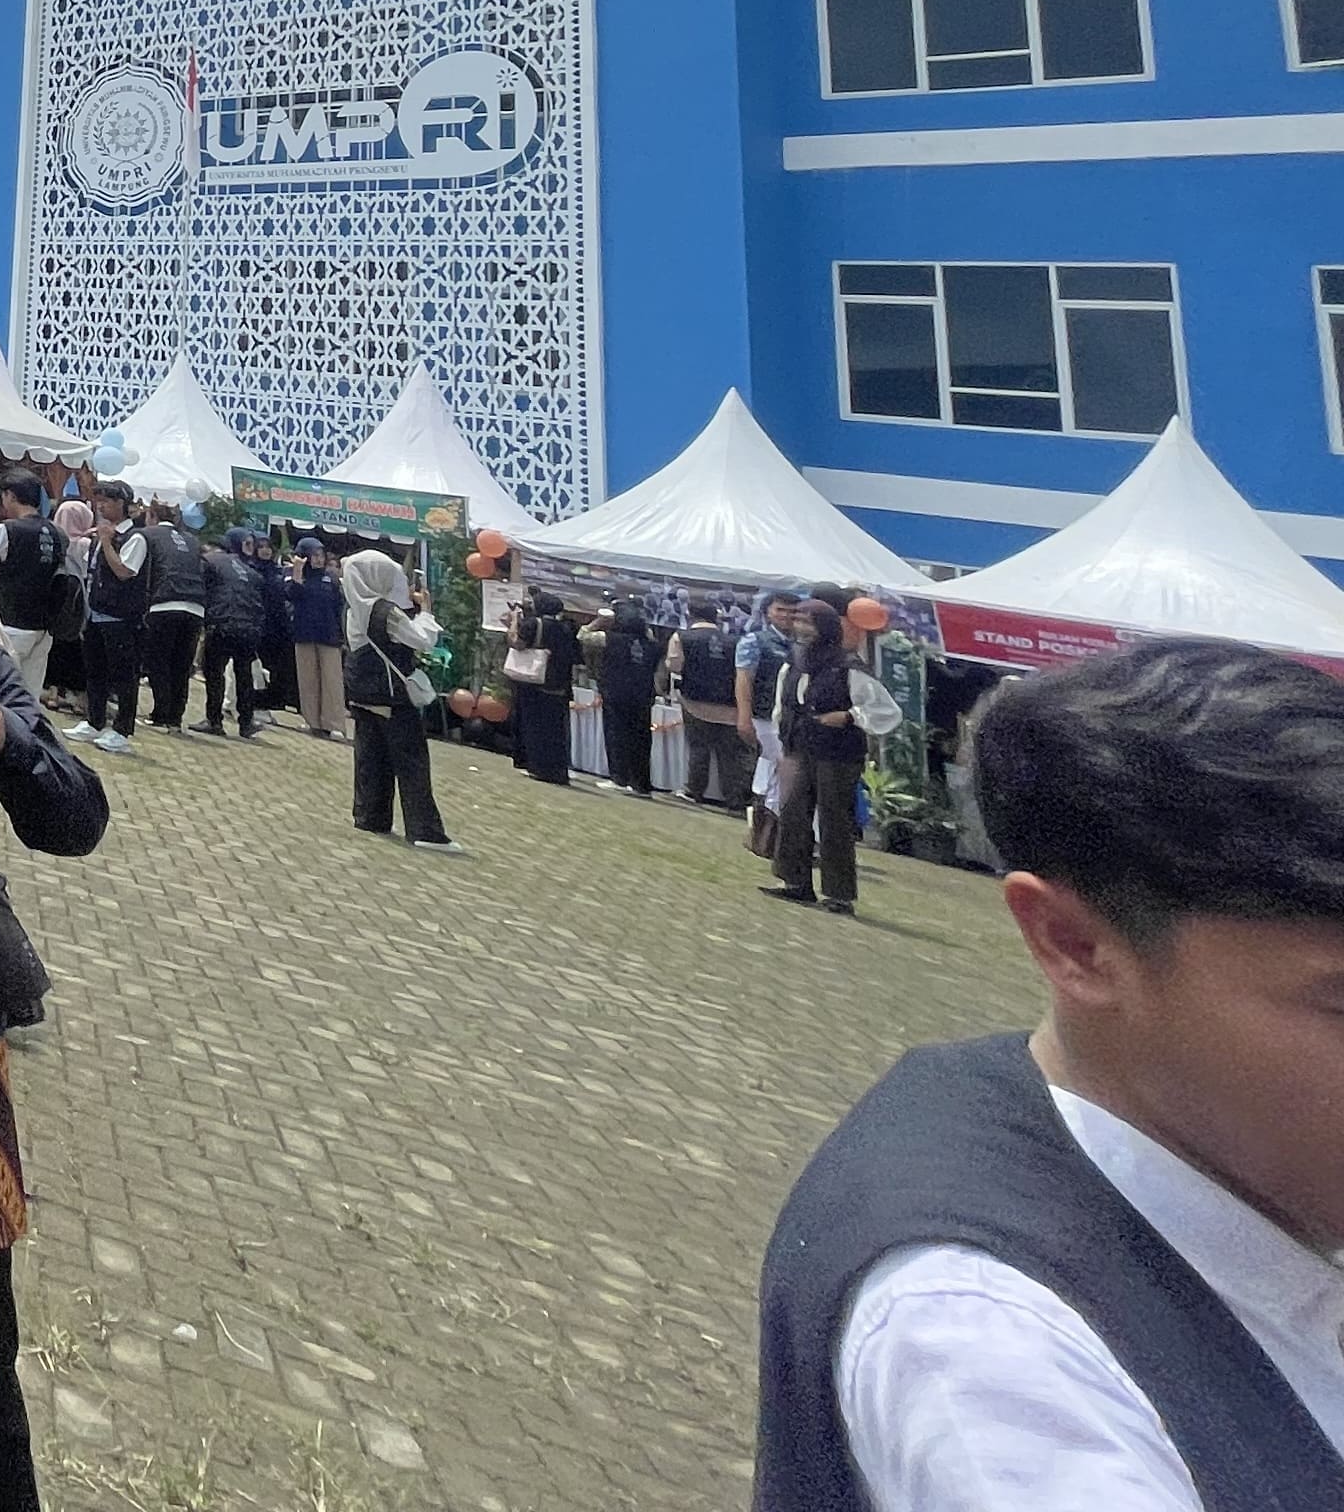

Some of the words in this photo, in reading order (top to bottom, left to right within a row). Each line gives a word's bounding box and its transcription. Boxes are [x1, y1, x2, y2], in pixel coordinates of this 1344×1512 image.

[97, 161, 152, 182] UMPRI
[209, 170, 265, 181] UNIVERSITAS
[97, 178, 150, 191] LAMPUNG
[312, 507, 357, 524] STAND
[974, 630, 1033, 649] STAND
